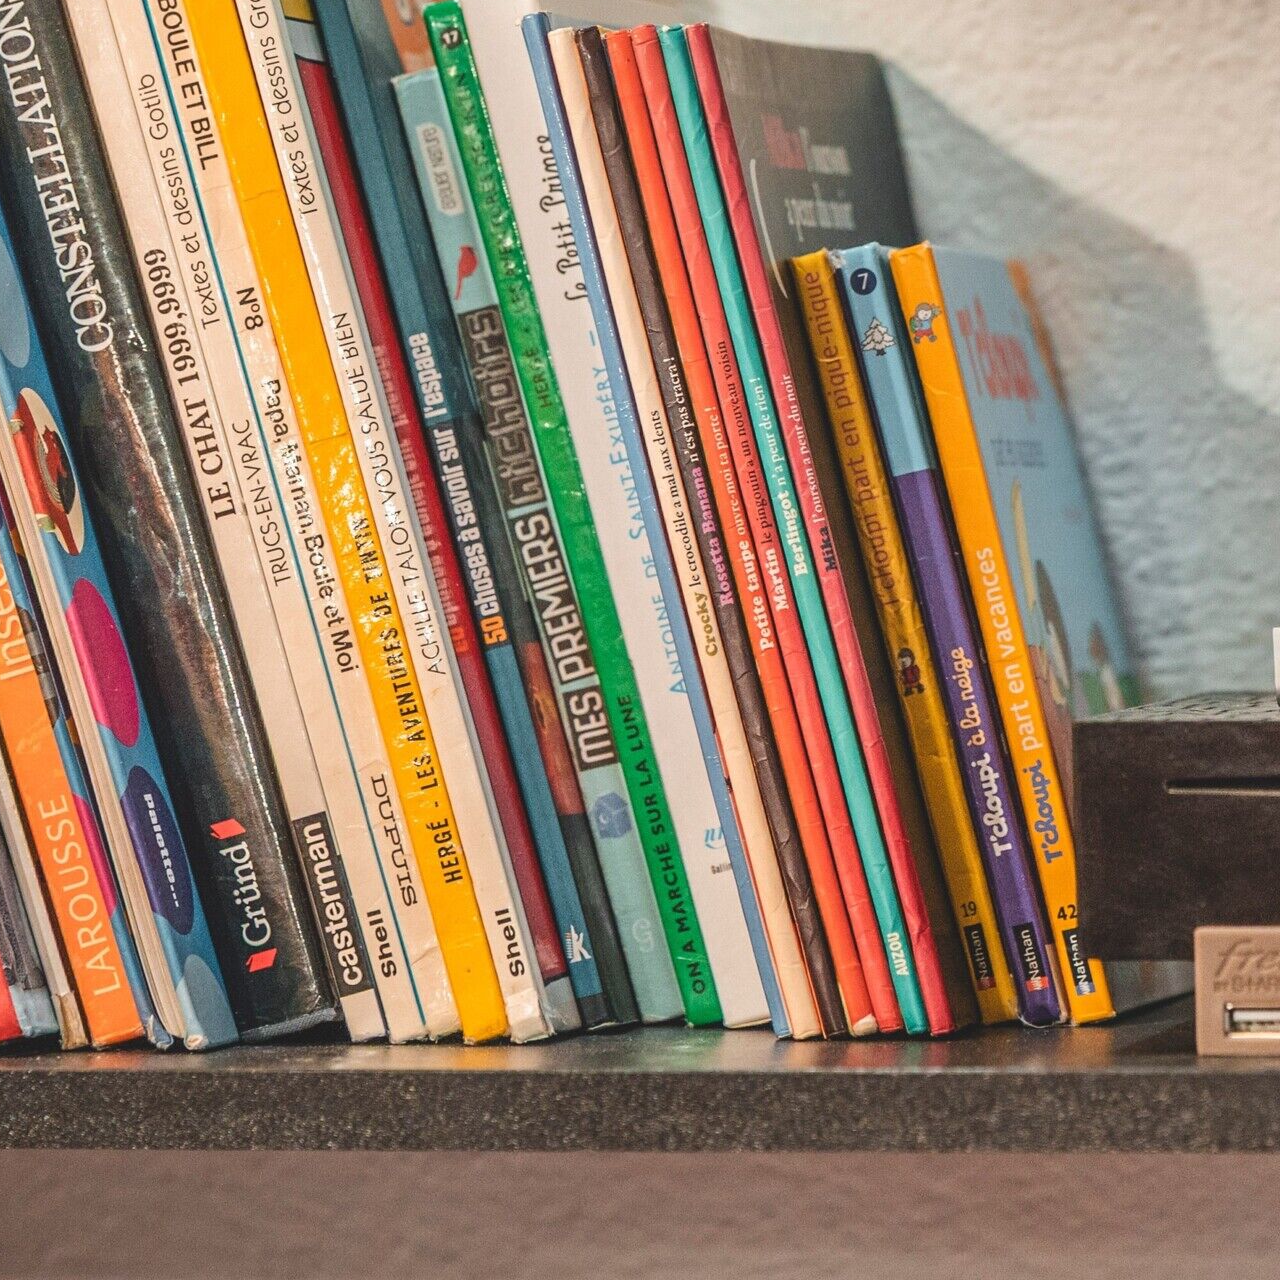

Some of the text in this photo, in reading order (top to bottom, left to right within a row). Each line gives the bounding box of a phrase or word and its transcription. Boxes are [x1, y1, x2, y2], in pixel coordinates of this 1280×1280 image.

[180, 81, 207, 111] ET
[259, 36, 292, 115] dessins
[190, 116, 219, 171] BILL
[279, 121, 300, 141] et
[138, 74, 221, 330] Textes et dessins Gotlib
[288, 150, 318, 215] Textes
[536, 133, 582, 275] Petit Prince
[521, 346, 554, 409] HERGÉ
[794, 271, 855, 412] pique-nique
[143, 248, 237, 521] LE CHAT 1999,9999
[677, 406, 695, 429] pas
[779, 374, 796, 402] noir
[791, 423, 810, 455] peur
[837, 418, 860, 448] en
[231, 419, 292, 587] TRUCS-EN-VRAC
[332, 312, 447, 675] ACHILLE TALON VOUS SALUE BIEN
[408, 332, 508, 645] 50 choses savoir sur l'espace
[691, 466, 716, 535] Banana
[717, 338, 790, 612] Martin pingouin nouveau voisin
[758, 413, 809, 577] Berlingot peur de
[841, 454, 877, 506] part
[303, 533, 336, 600] Boule
[650, 410, 719, 657] Crocky crocodile mal dents
[715, 449, 775, 650] Petite taupe ouvre-moi ta
[819, 525, 839, 573] Mika
[708, 537, 734, 607] Rosetta
[323, 605, 345, 628] et
[330, 629, 360, 673] Moi
[514, 514, 614, 764] MES PREMIERS
[369, 591, 464, 884] HERGÉ LES AVENTURES DE
[976, 547, 1063, 864] T'choupi part en vacances
[950, 646, 1013, 857] T'choupi la neige
[370, 773, 418, 907] DUPUIS
[616, 694, 706, 995] ON MARCHÉ SUR LA LUNE
[37, 794, 121, 996] LAROUSSE
[219, 840, 272, 947] Gründ
[303, 821, 363, 986] casterman
[366, 909, 397, 978] Shell
[494, 908, 525, 977] Shell
[886, 932, 910, 977] AUZOU
[970, 930, 990, 980] Nathan
[1020, 929, 1042, 980] Nathan
